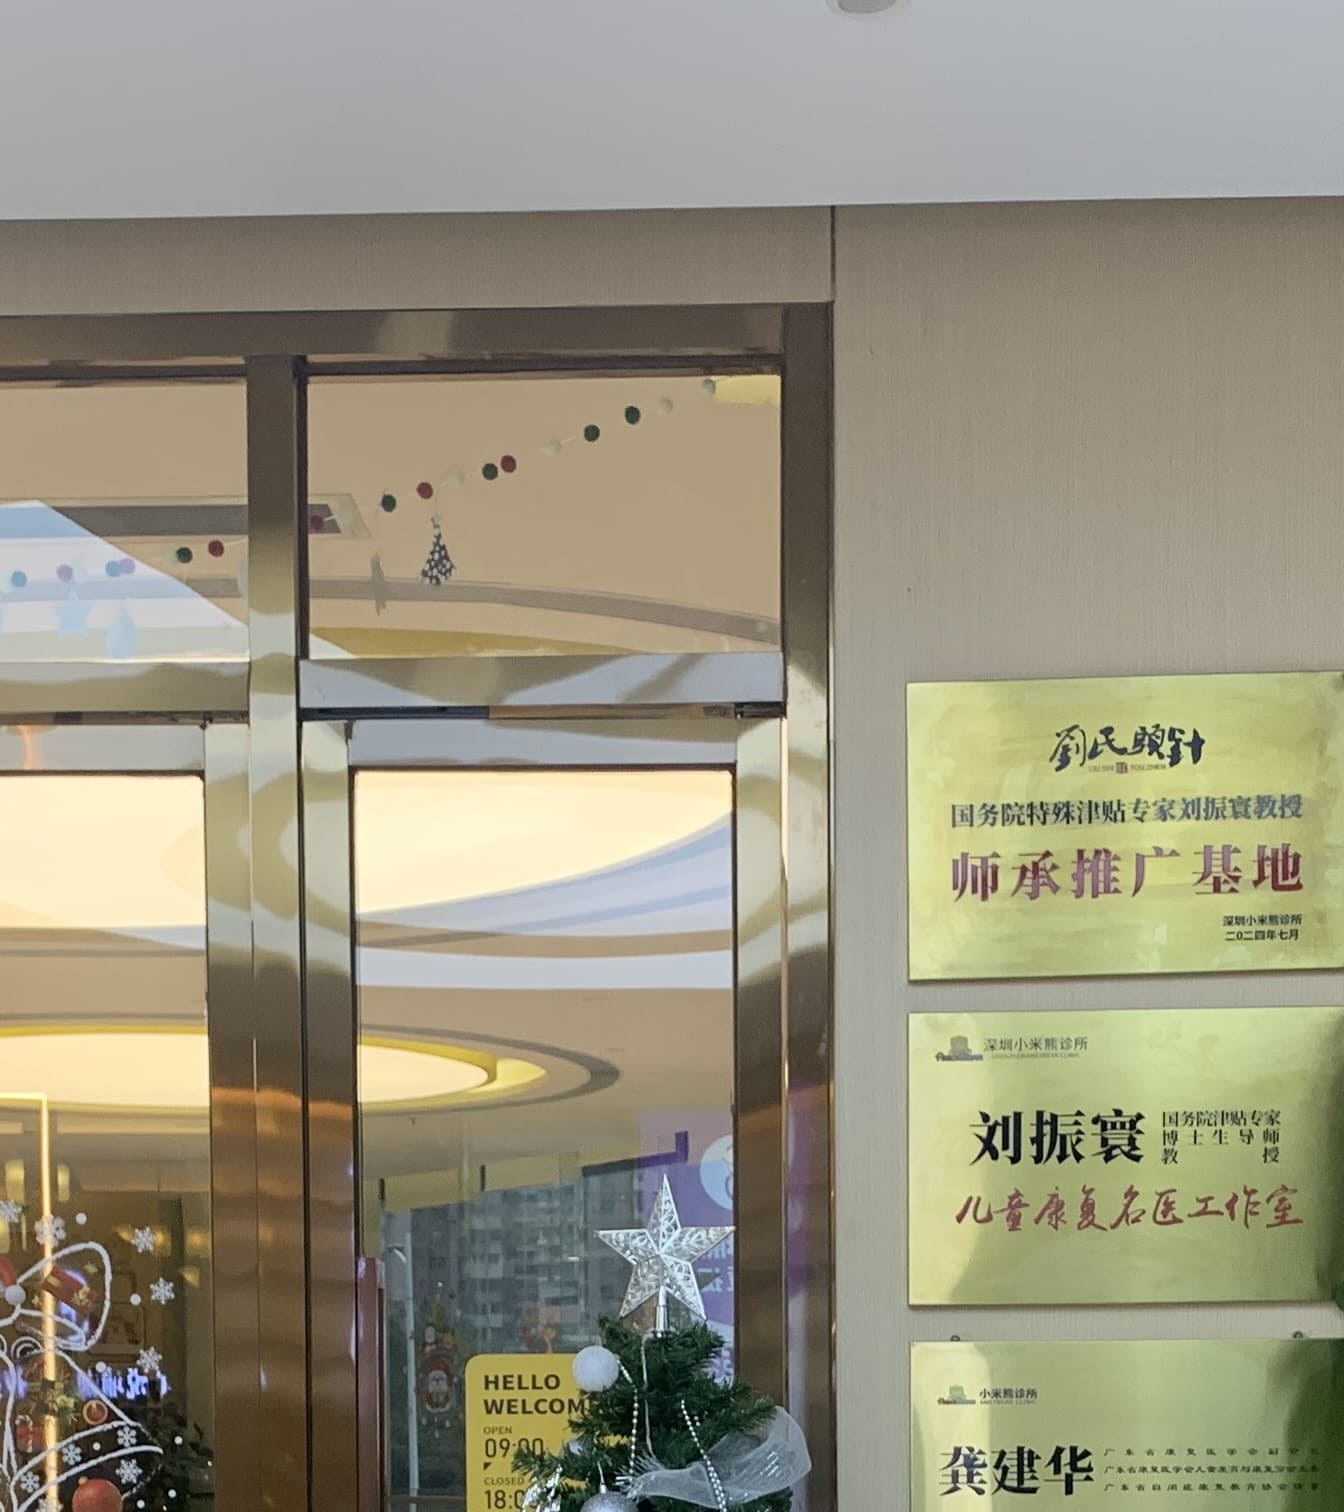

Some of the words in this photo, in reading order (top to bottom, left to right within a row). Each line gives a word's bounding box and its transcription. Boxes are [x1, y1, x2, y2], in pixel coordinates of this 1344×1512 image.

[951, 793, 1303, 828] 国务院特殊津贴专家刘振寰教授
[952, 843, 1304, 902] 师承推广基地
[983, 1036, 1088, 1052] 深圳小米熊诊所
[1162, 1109, 1281, 1128] 国务院津贴专家
[969, 1108, 1146, 1166] 刘振寰
[955, 1184, 1304, 1233] 儿童康复名医工作室
[484, 1373, 561, 1391] HELLO
[484, 1398, 590, 1415] WELCOM
[483, 1426, 513, 1435] OPEN
[939, 1445, 1095, 1496] 龚建华
[484, 1476, 525, 1486] CLOSED
